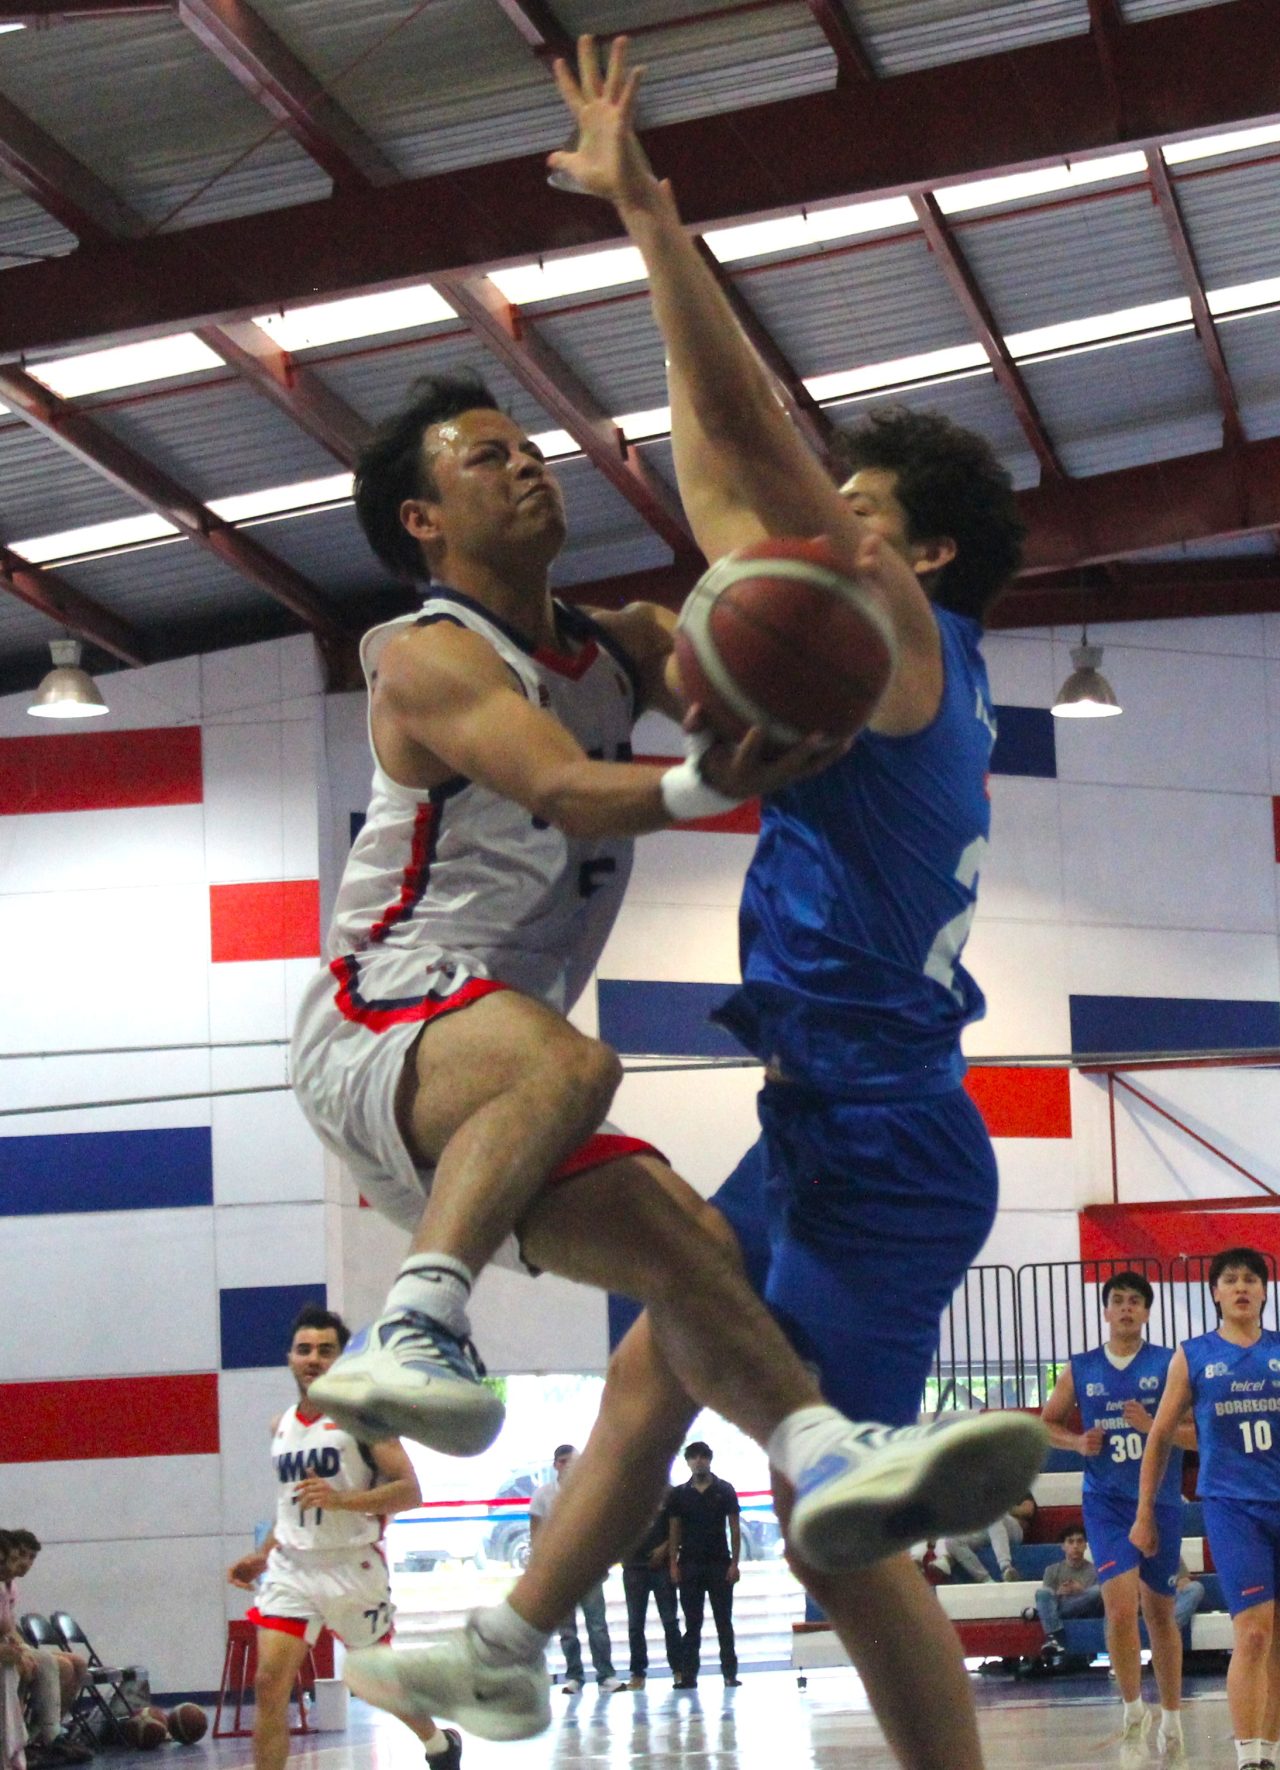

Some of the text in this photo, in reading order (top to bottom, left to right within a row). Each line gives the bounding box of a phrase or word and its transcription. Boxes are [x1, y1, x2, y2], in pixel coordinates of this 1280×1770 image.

[1231, 1380, 1266, 1392] telcel
[1110, 1433, 1142, 1463] 30
[1239, 1420, 1273, 1453] 10
